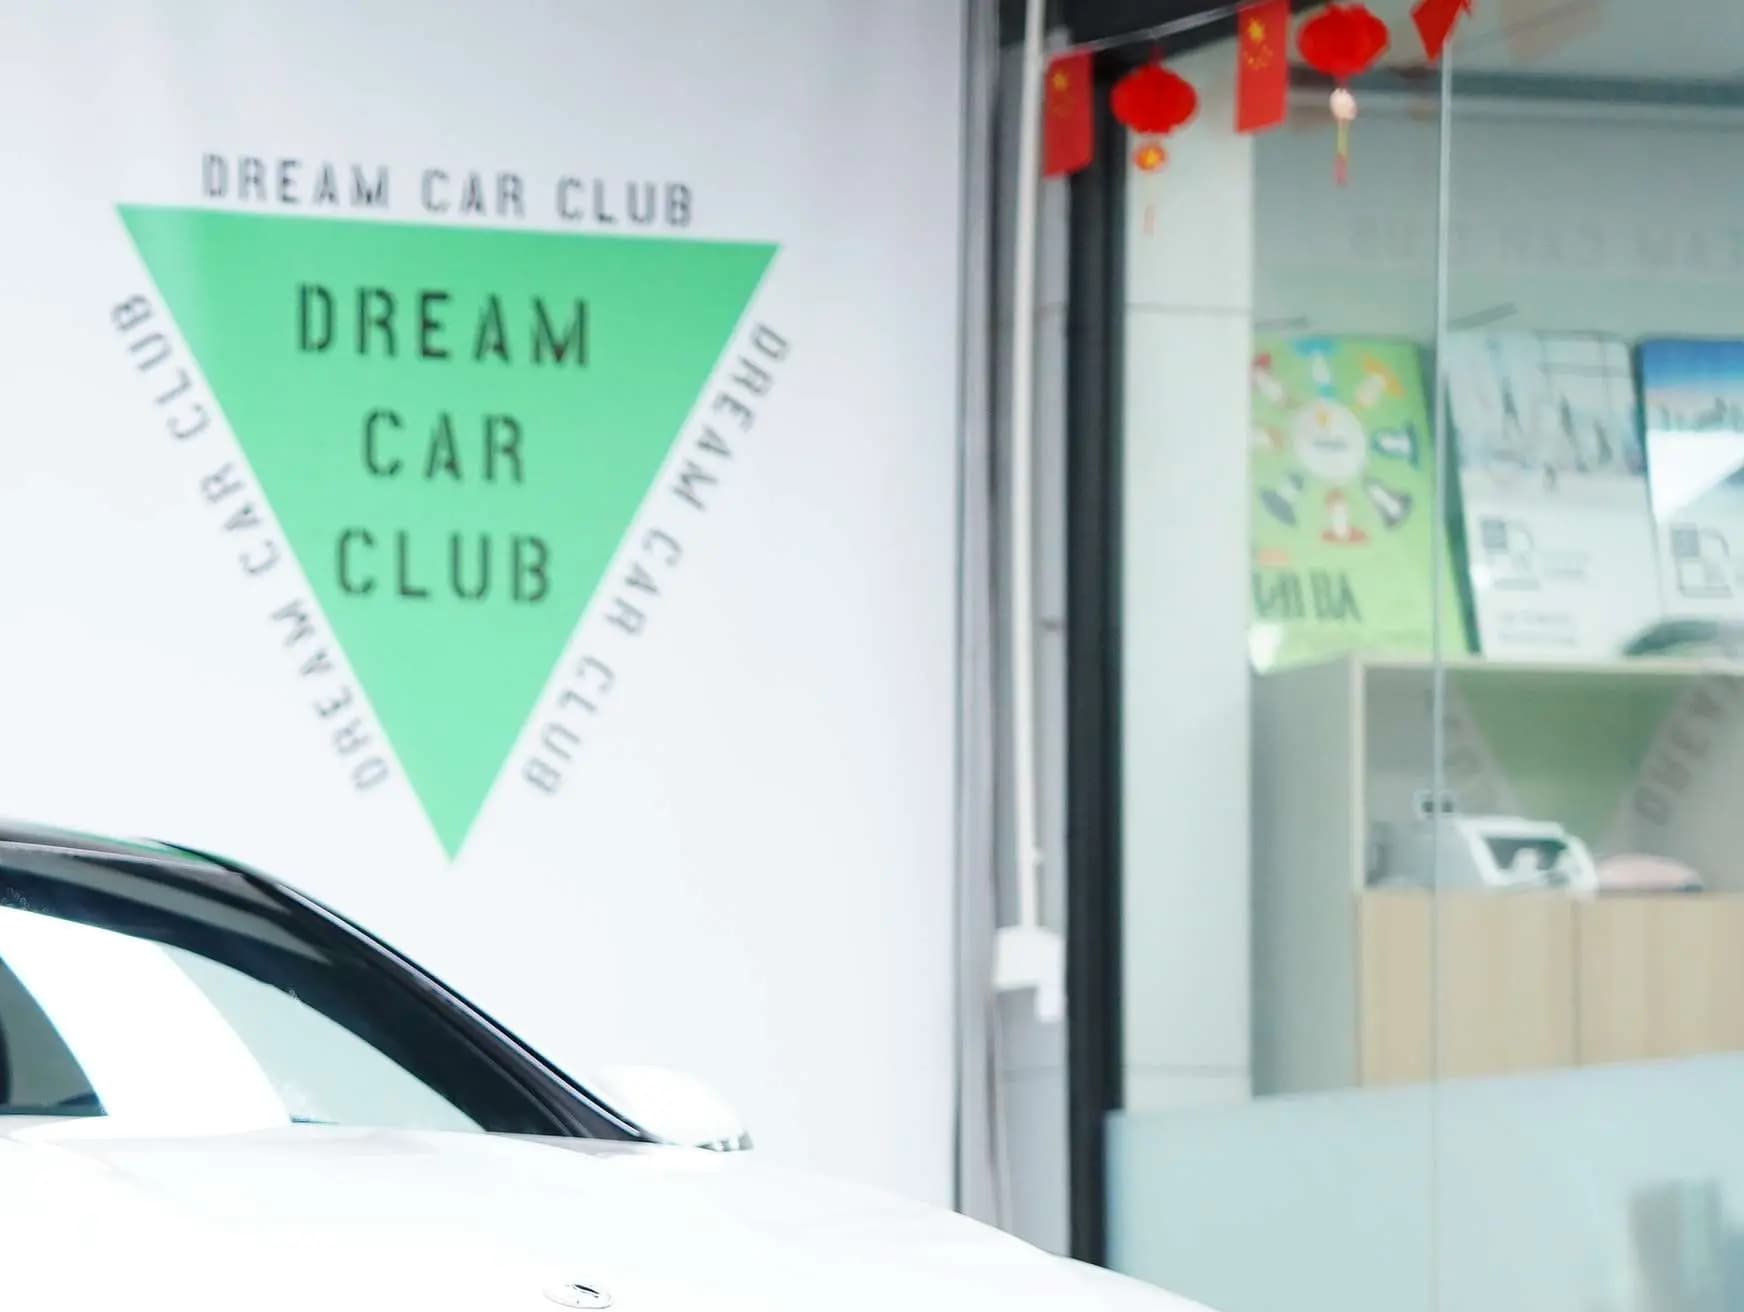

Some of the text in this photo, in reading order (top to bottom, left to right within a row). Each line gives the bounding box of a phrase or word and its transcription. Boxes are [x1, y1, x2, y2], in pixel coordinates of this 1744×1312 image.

[201, 153, 694, 228] DREAM CAR CLUB
[295, 282, 591, 370] DREAM
[360, 407, 527, 484] CAR
[109, 294, 390, 793] DREAM CAR CLUB
[333, 527, 553, 605] CLUB
[523, 323, 792, 796] DREAM CAR CLUB
